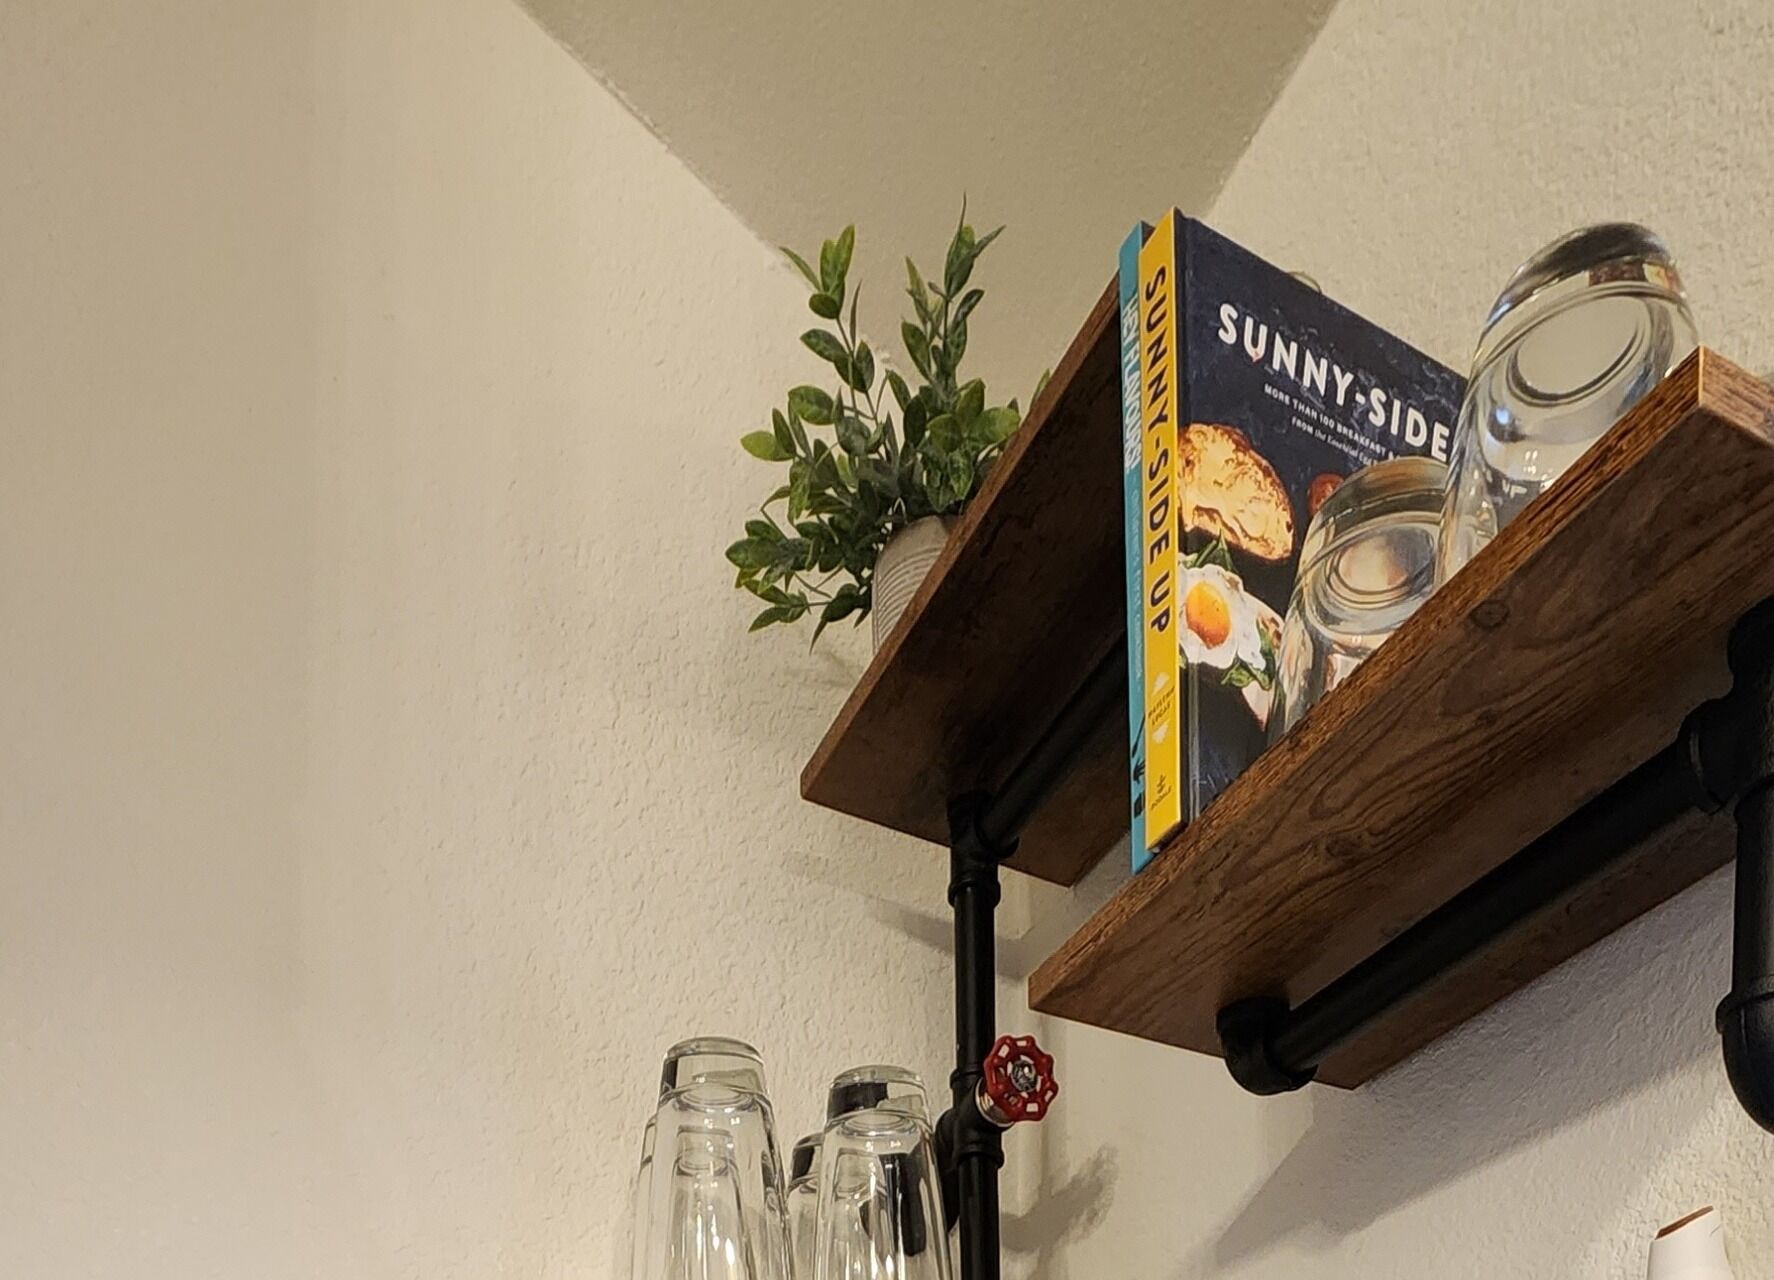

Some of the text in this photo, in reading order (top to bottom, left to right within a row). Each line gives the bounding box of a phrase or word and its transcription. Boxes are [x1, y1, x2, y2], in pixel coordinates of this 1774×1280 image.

[1217, 303, 1450, 462] SUNNY-SIDE
[1264, 383, 1290, 405] MORE
[1293, 399, 1317, 420] THAN
[1319, 414, 1335, 429] 100
[1336, 422, 1386, 456] BREAKFAST
[1291, 416, 1313, 434] FROM
[1314, 430, 1326, 441] the
[1145, 265, 1171, 632] SUNNY-SIDE UP
